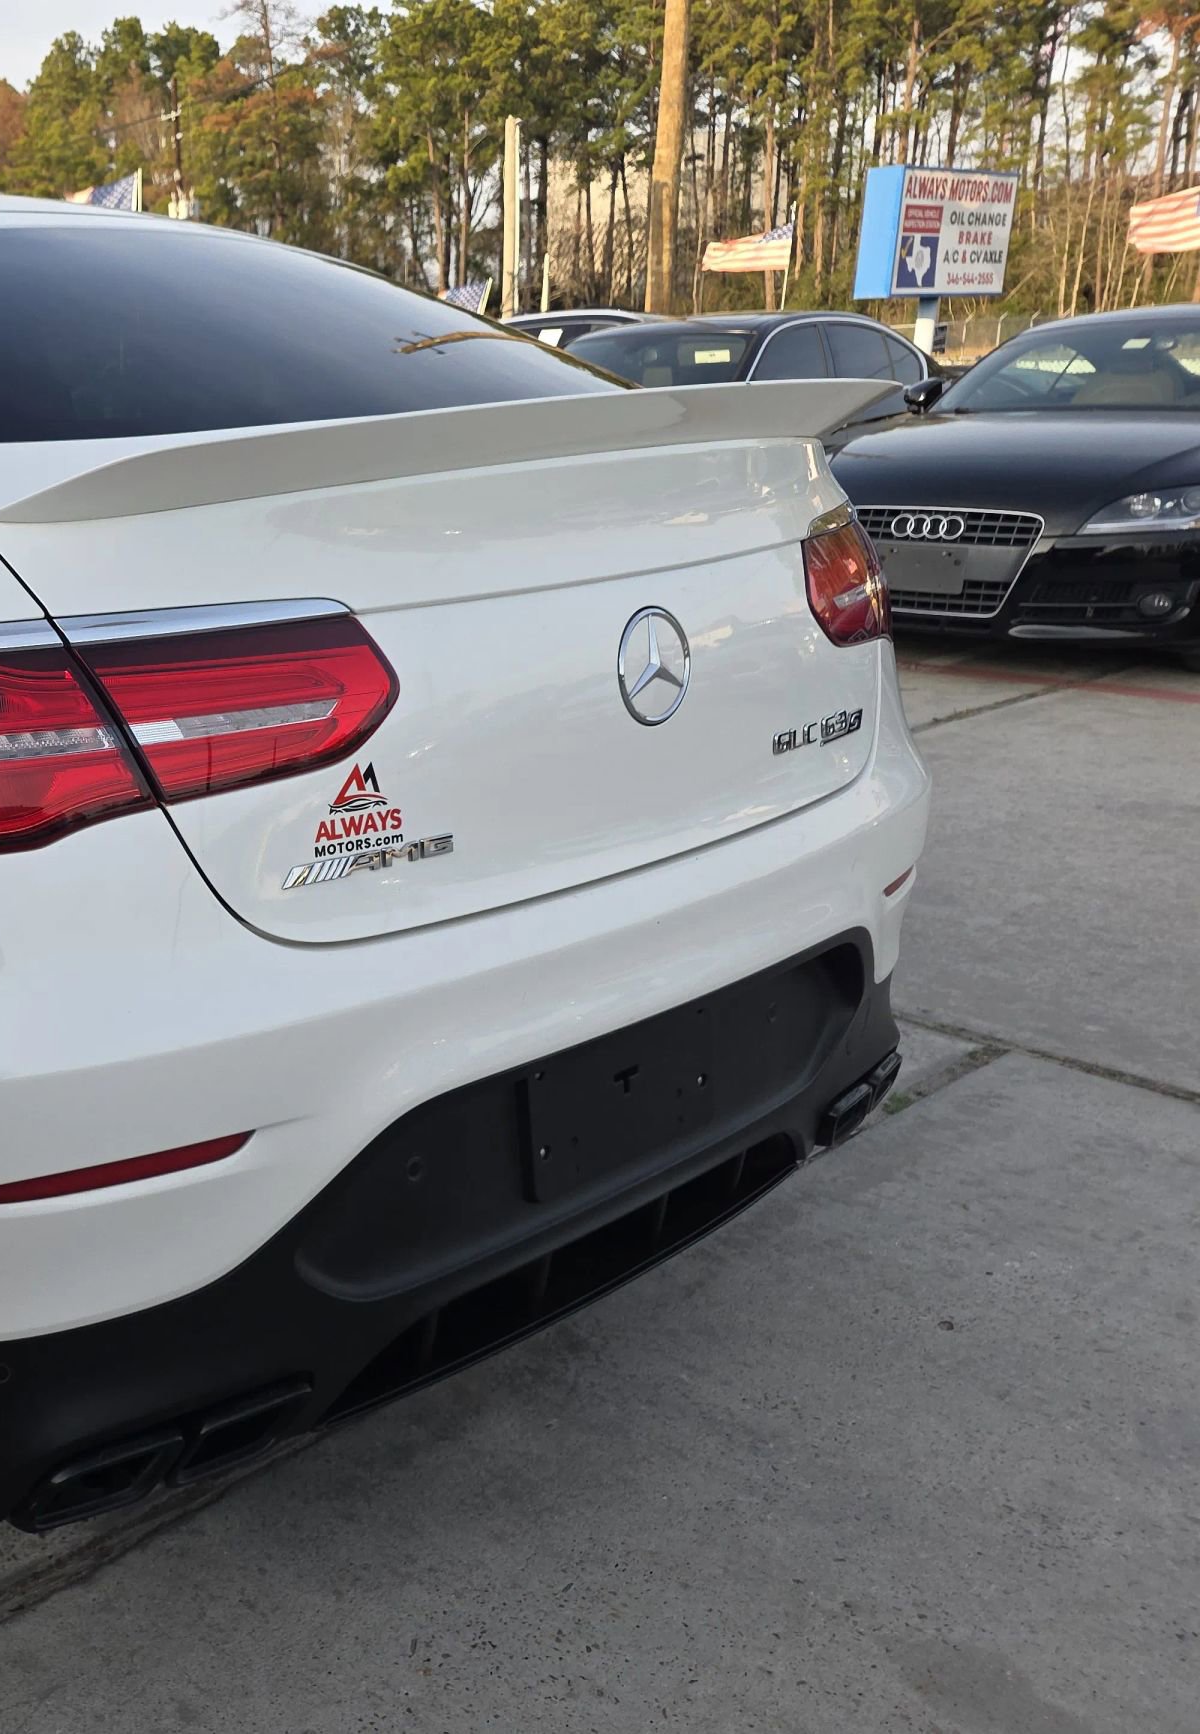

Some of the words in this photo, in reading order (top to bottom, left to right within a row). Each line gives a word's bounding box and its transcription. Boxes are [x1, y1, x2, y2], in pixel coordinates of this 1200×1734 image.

[905, 176, 948, 200] ALWAYS
[949, 180, 1013, 203] MOTORS.COM
[950, 211, 965, 226] OIL
[968, 212, 1007, 227] CHANGE
[958, 231, 993, 245] BRAKE
[772, 722, 818, 756] GLC
[315, 809, 402, 843] ALWAYS
[314, 833, 404, 858] MOTORS.com
[349, 833, 454, 872] AMG
